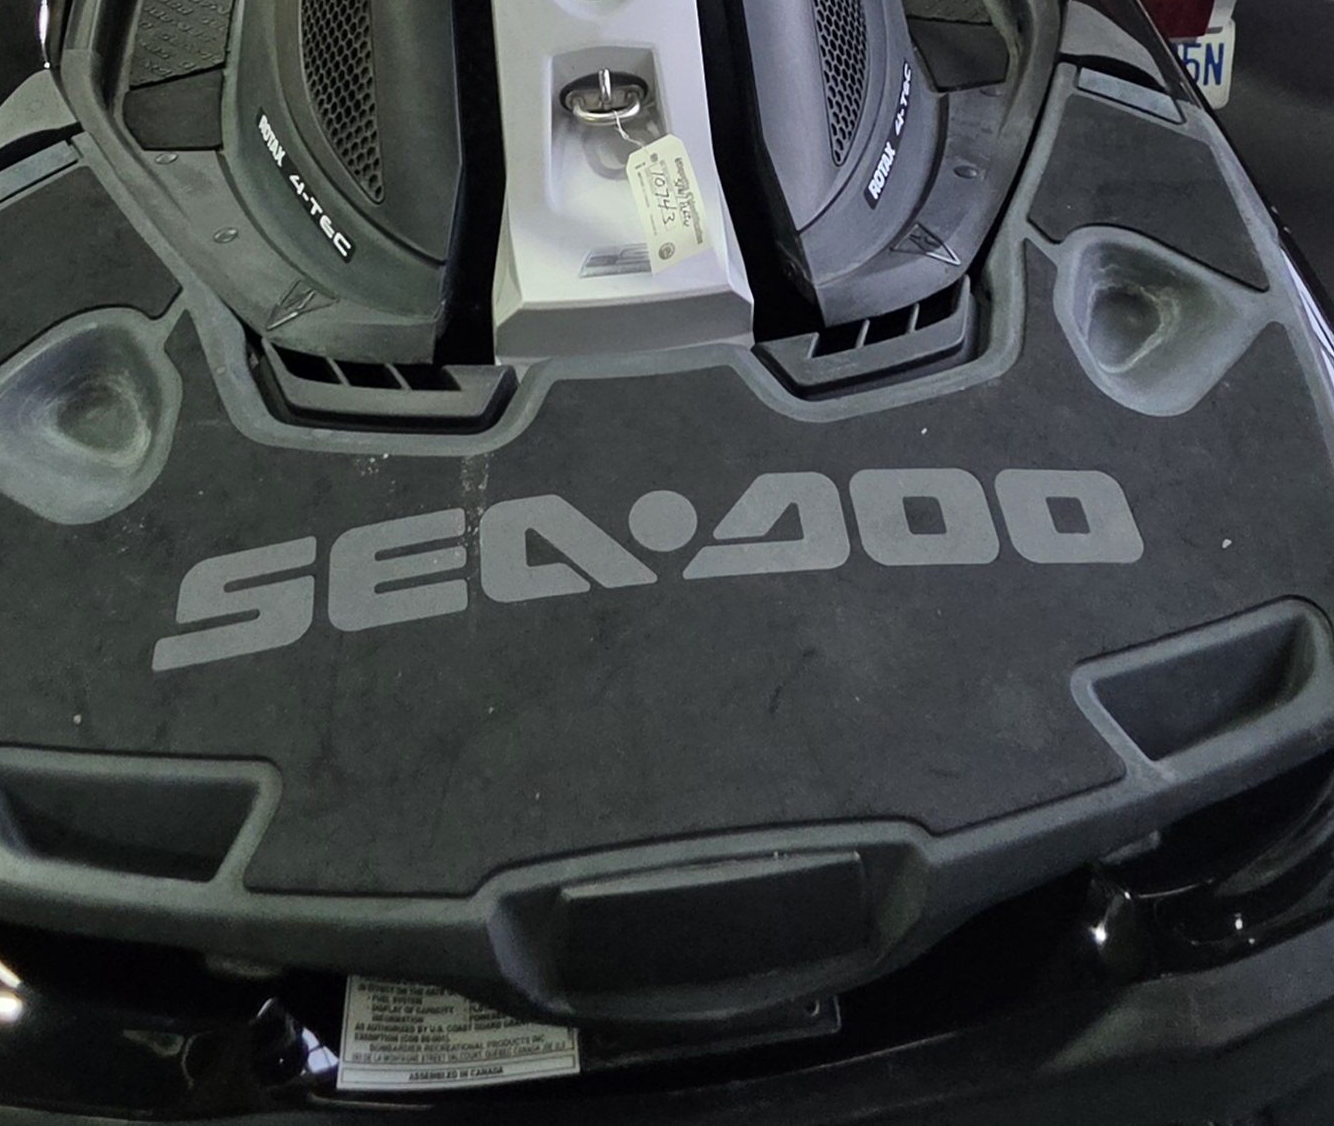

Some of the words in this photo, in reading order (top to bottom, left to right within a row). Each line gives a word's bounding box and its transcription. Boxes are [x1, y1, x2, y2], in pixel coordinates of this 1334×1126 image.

[258, 114, 286, 167] ROTAX
[289, 174, 353, 258] 4-TEC
[650, 171, 678, 226] 10743
[868, 140, 896, 201] ROTAX
[409, 1069, 457, 1080] ASSEMBLED
[470, 1066, 504, 1077] CANADA
